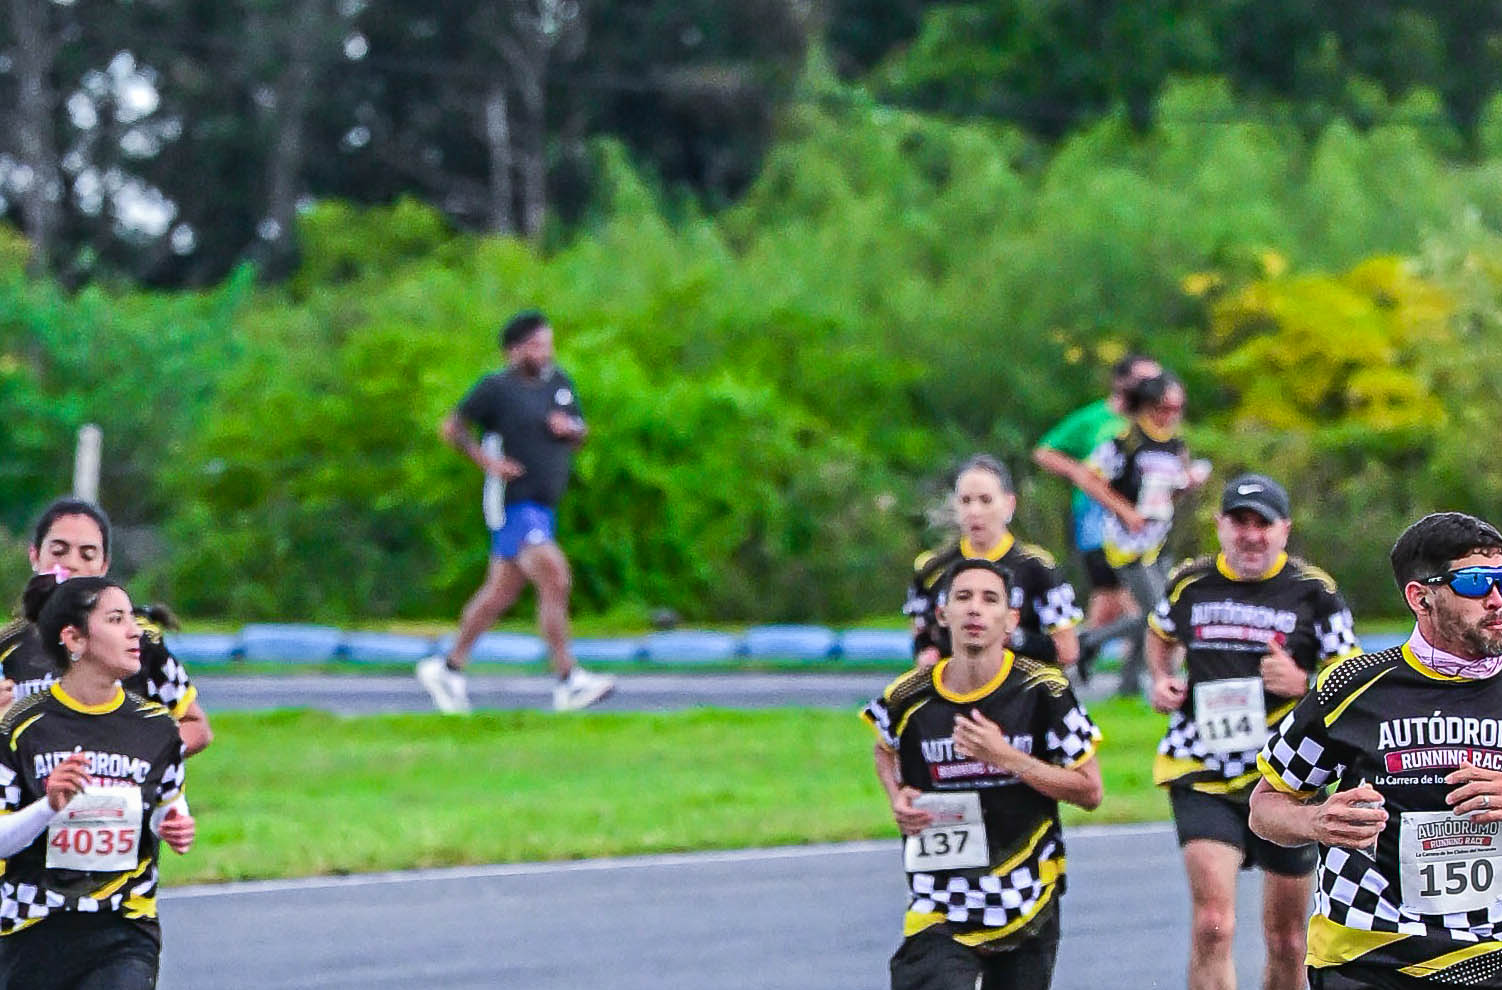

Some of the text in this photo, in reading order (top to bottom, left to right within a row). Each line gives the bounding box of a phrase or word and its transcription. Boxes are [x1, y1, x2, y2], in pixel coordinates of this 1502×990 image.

[1206, 717, 1252, 739] 114
[1401, 750, 1468, 770] RUNNING
[1375, 776, 1385, 785] La
[1386, 775, 1419, 785] Carrera
[1420, 775, 1434, 785] de
[1418, 817, 1499, 840] AUTÓDROMO
[51, 827, 135, 856] 4035
[916, 830, 969, 858] 137
[1420, 859, 1494, 897] 150
